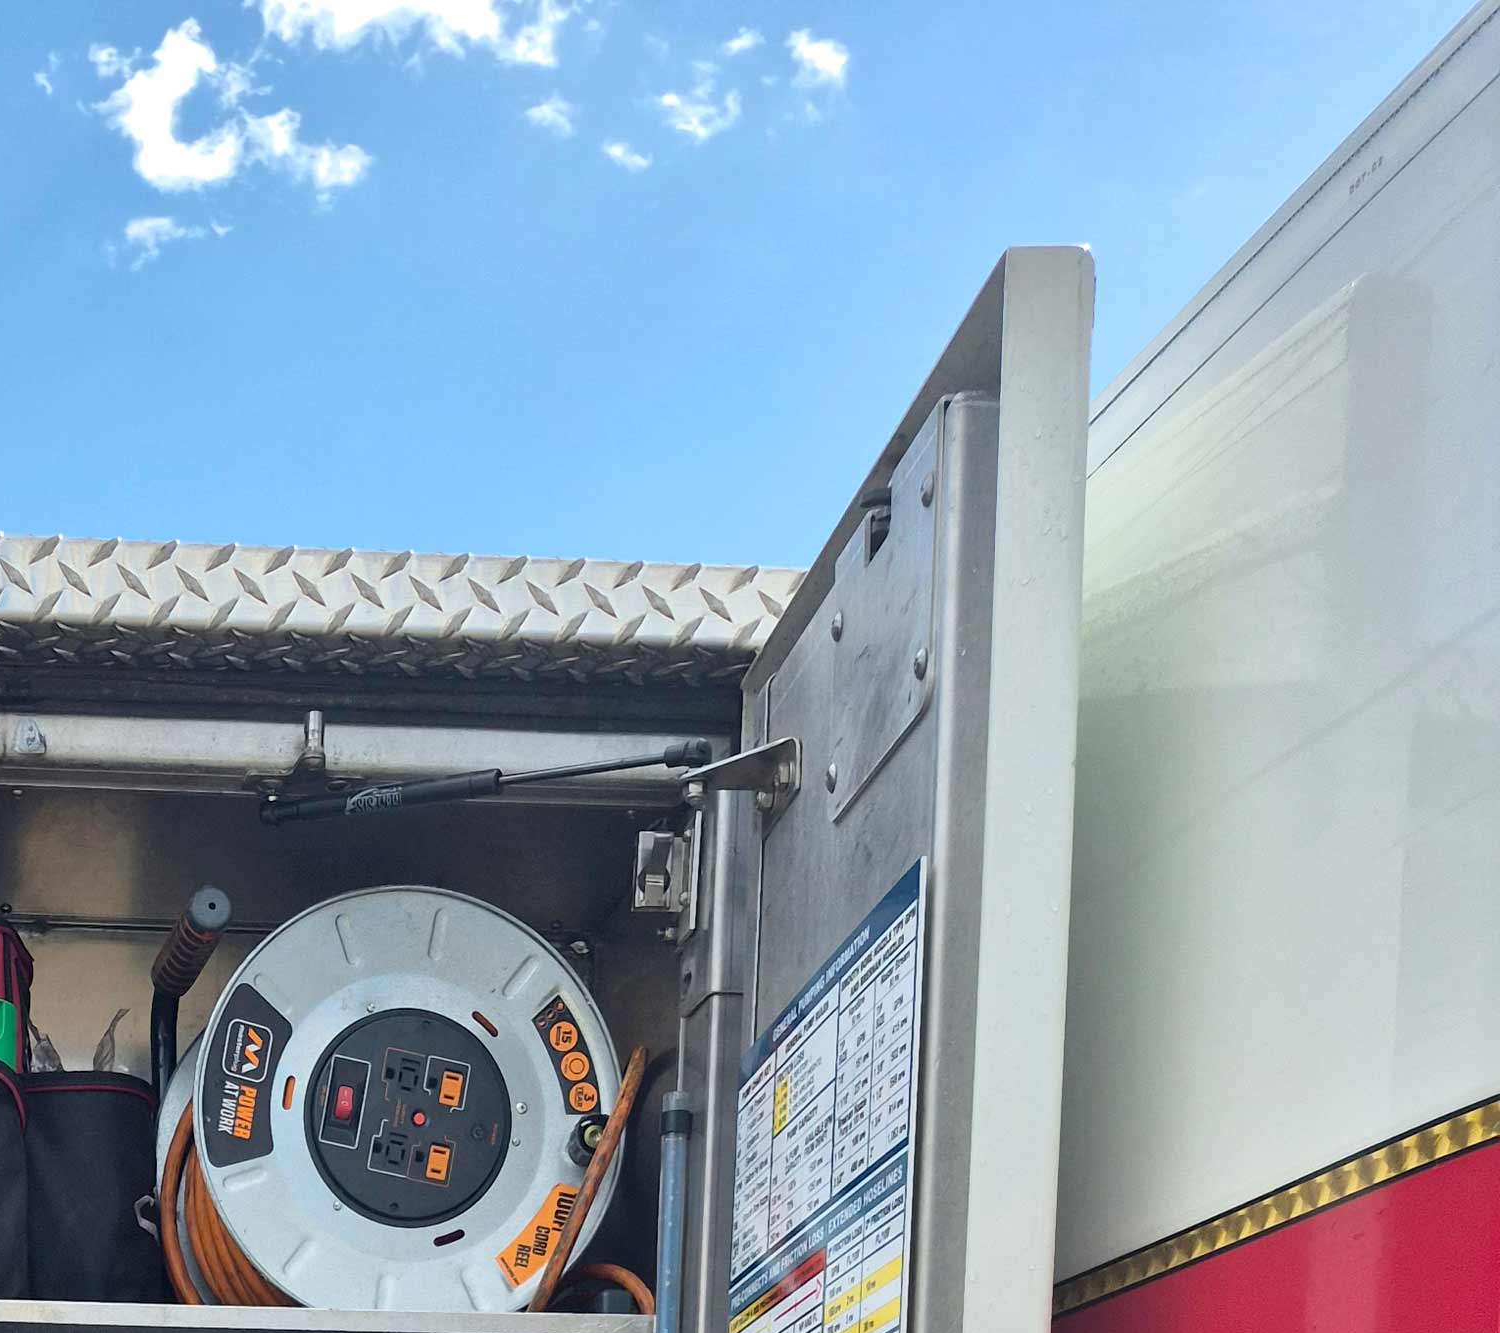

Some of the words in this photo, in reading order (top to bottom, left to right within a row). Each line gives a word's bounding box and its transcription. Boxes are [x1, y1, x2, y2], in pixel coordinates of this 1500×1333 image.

[223, 1080, 239, 1099] AT
[217, 1098, 237, 1135] WORK
[233, 1085, 257, 1141] POWER
[827, 1196, 861, 1233] EXTENDED
[862, 1164, 903, 1206] HOSELINES
[514, 1244, 531, 1268] REEL
[532, 1225, 551, 1256] CORD
